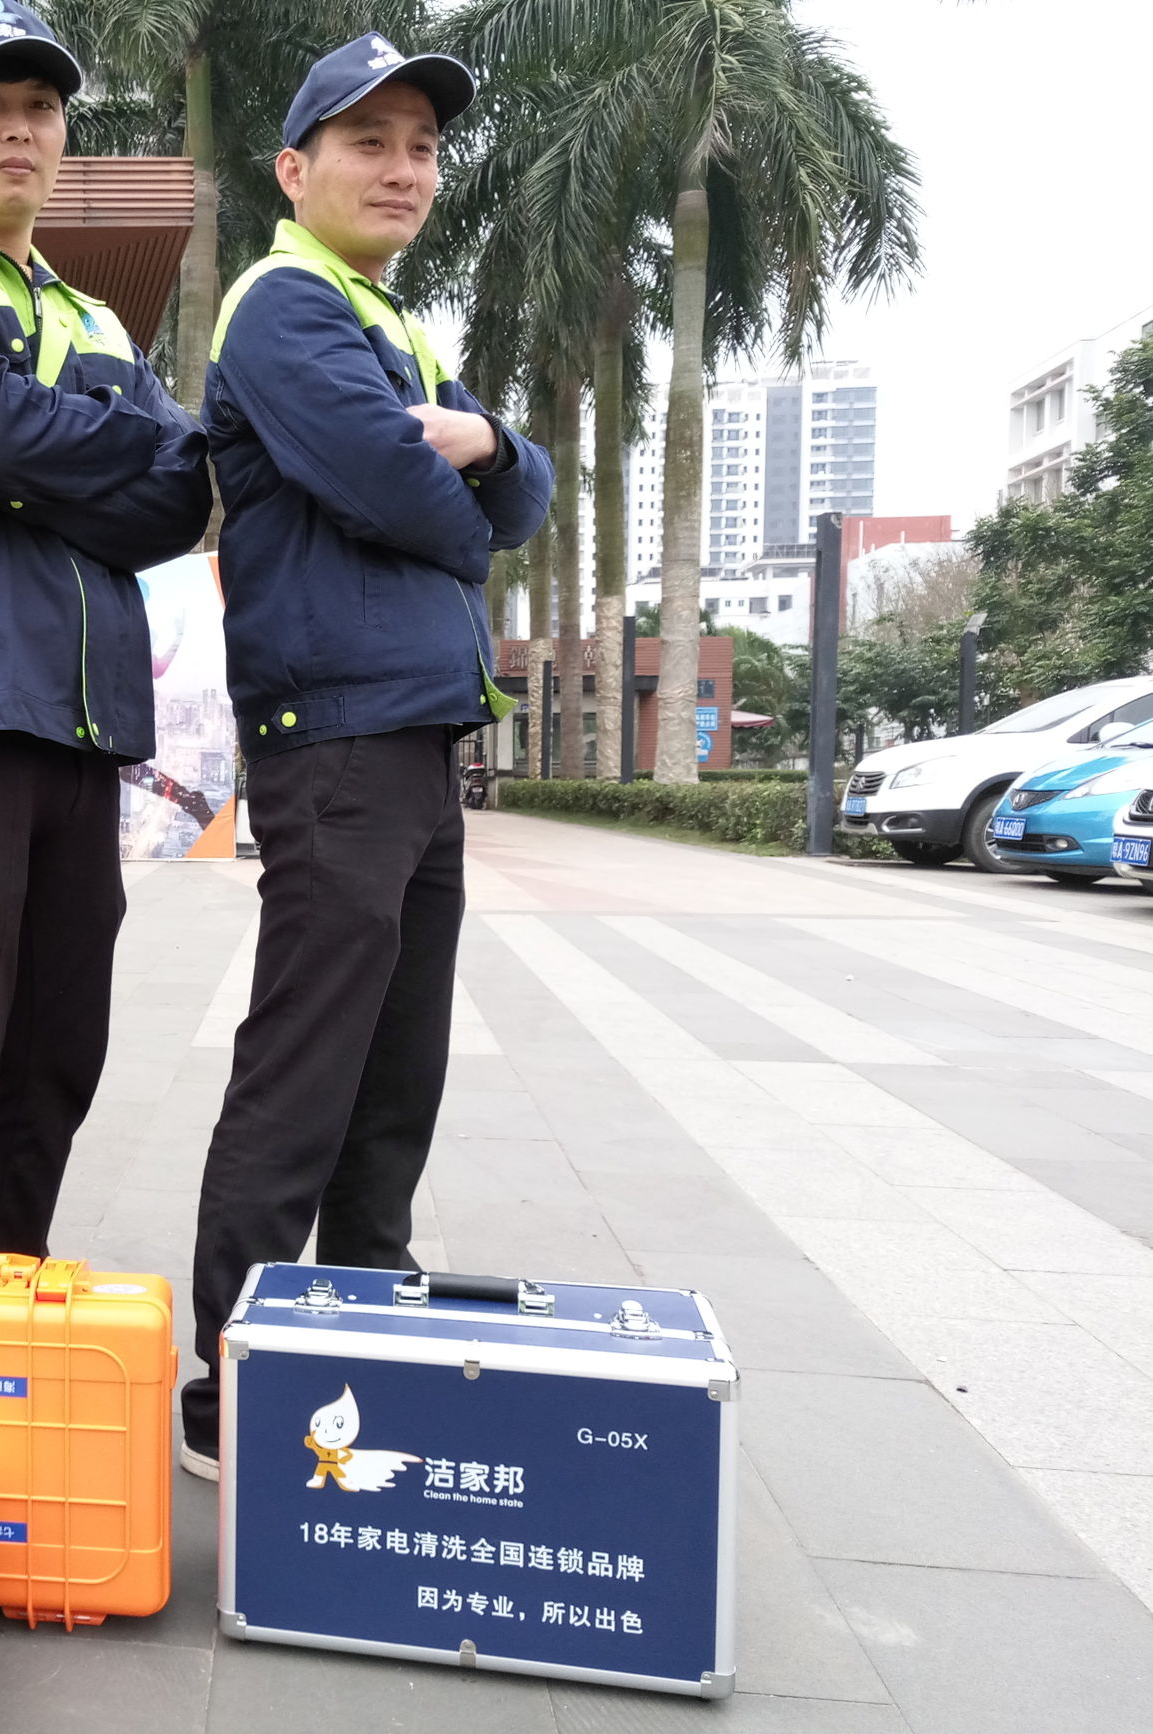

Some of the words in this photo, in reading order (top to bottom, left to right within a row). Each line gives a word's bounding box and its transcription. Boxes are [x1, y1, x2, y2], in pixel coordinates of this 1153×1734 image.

[577, 1427, 648, 1450] G-05X
[424, 1457, 525, 1495] 洁家邦
[423, 1489, 451, 1500] Clean
[452, 1493, 468, 1502] the
[470, 1494, 498, 1506] home
[499, 1498, 524, 1509] state
[299, 1521, 646, 1582] 18年家电清洗全国连锁品牌
[417, 1585, 644, 1635] 因为专业，所以出色
